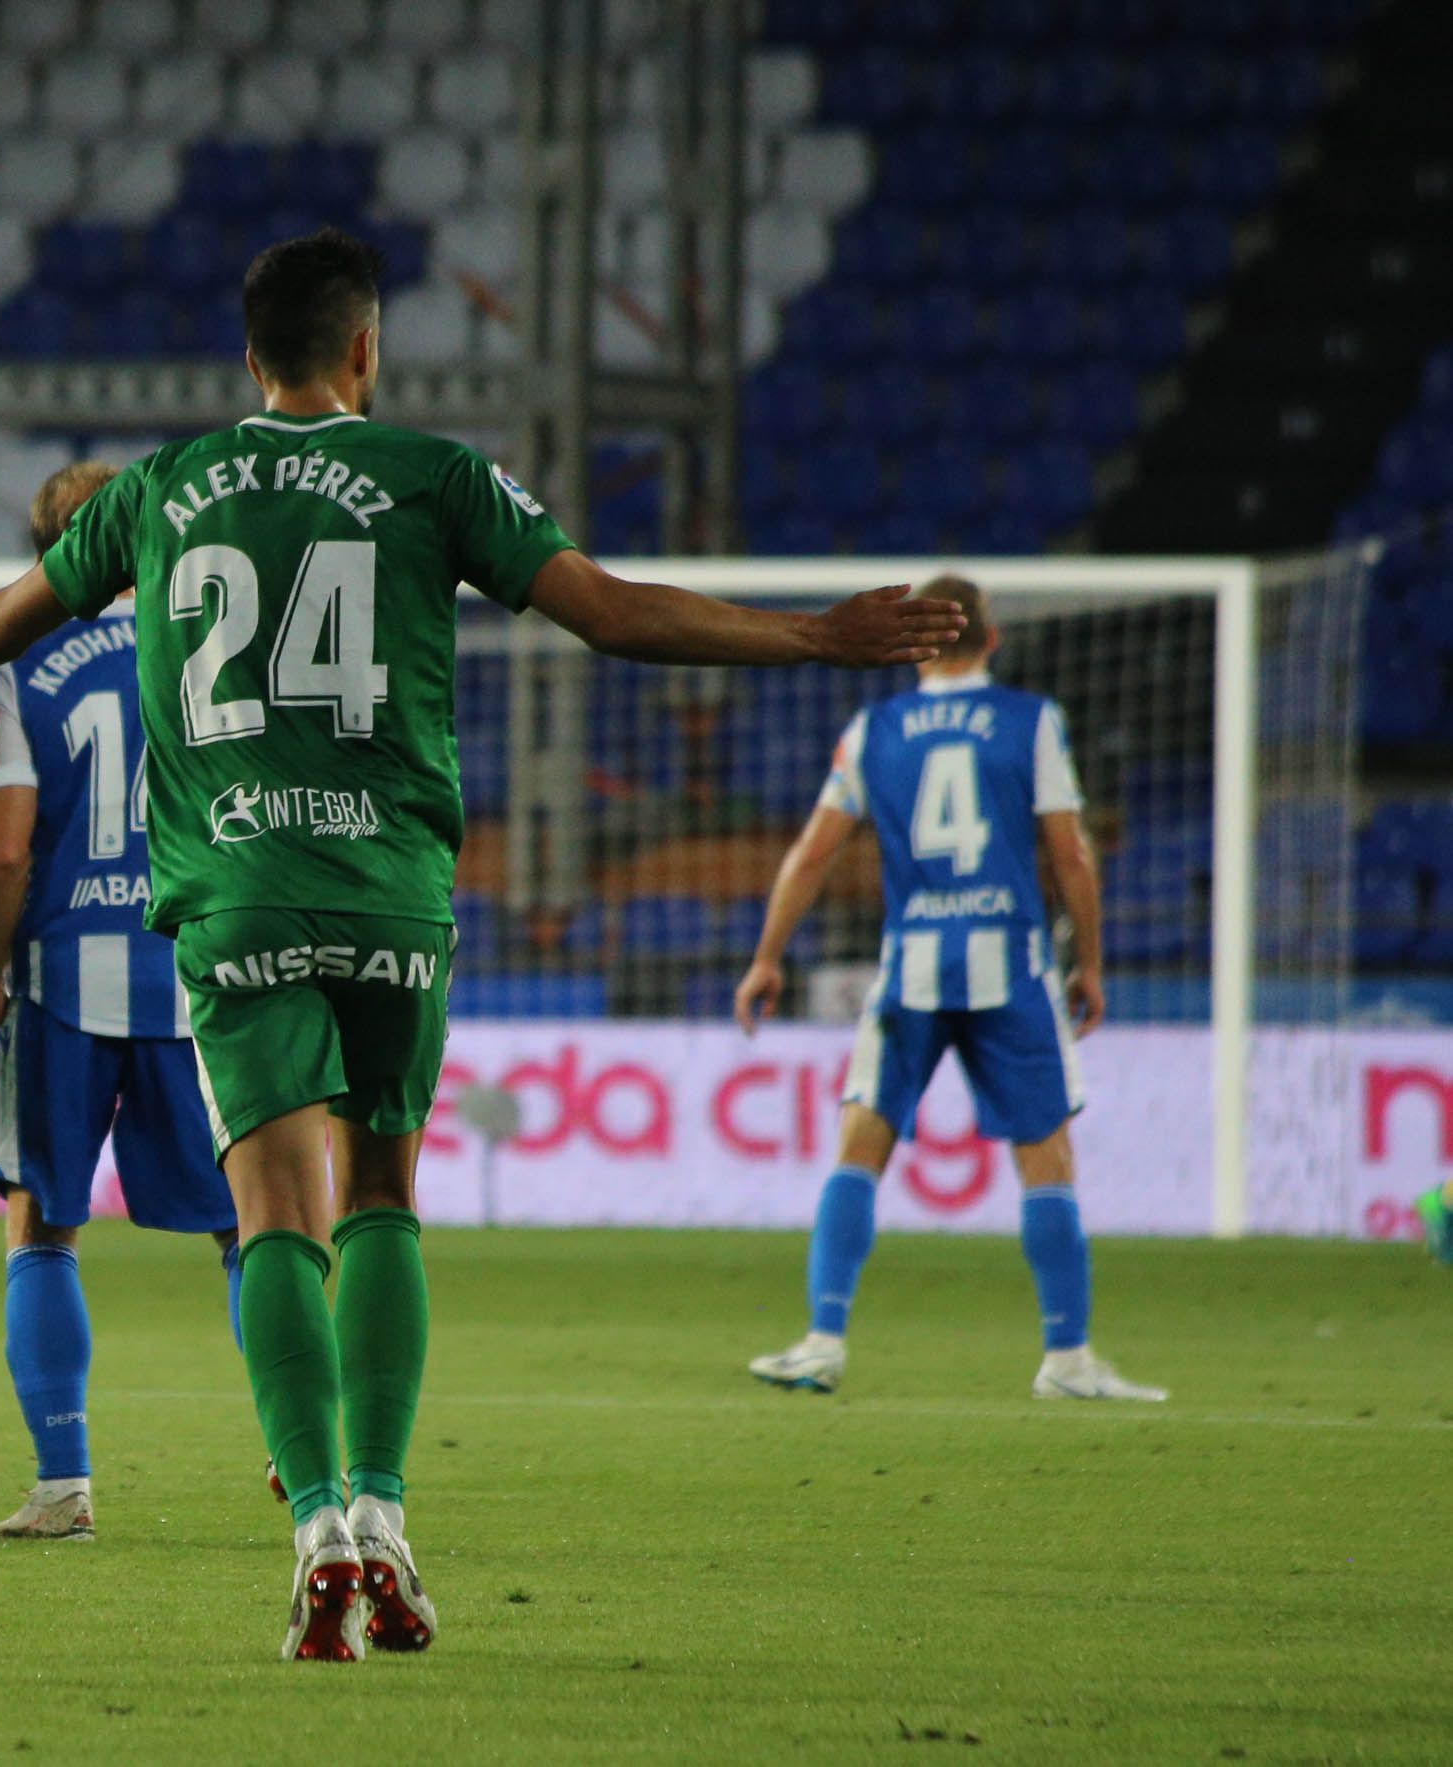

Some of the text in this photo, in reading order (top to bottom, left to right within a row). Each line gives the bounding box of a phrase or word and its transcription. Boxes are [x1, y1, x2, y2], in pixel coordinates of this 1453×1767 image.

[162, 449, 395, 536] ALEX PÉREZ
[168, 540, 388, 746] 24
[264, 787, 379, 829] INTEGRA
[910, 742, 992, 877] 4
[214, 945, 437, 990] NISSAN
